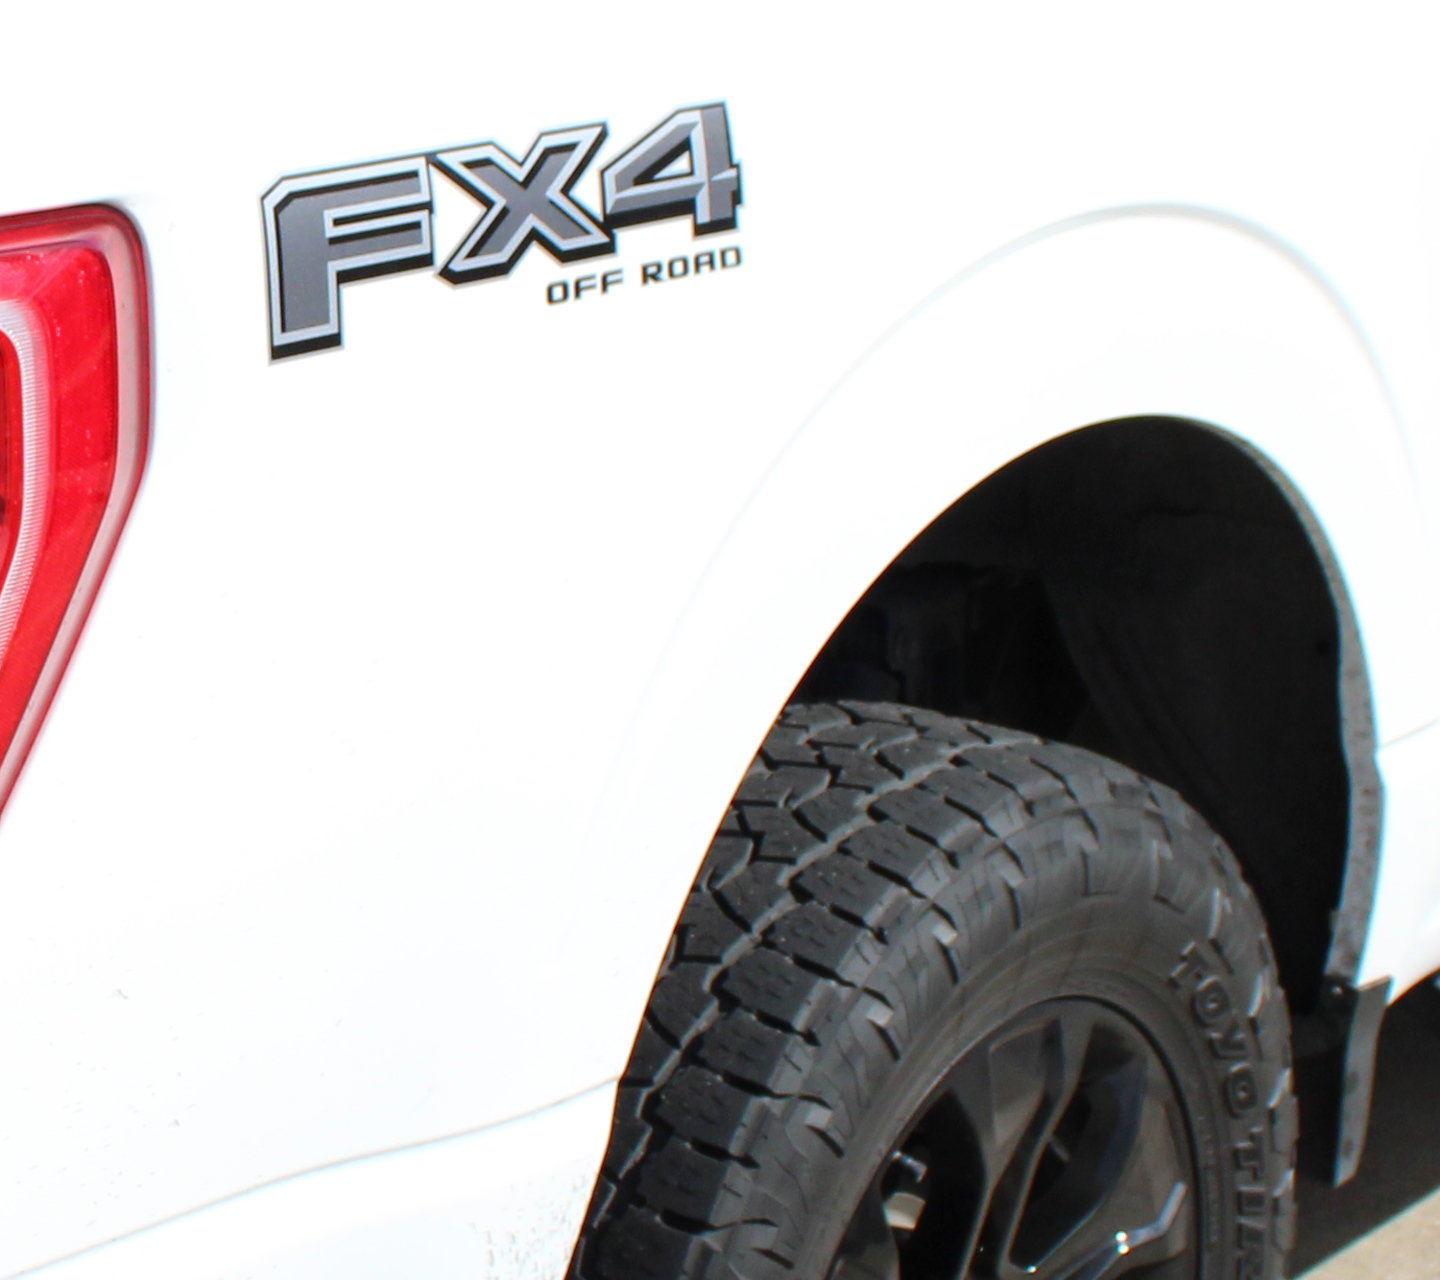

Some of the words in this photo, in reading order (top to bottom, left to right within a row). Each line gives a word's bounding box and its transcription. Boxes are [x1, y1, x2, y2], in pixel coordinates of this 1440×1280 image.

[259, 98, 742, 363] FX4
[546, 270, 624, 306] OFF
[641, 247, 742, 286] ROAD
[1168, 940, 1258, 1119] TOYO
